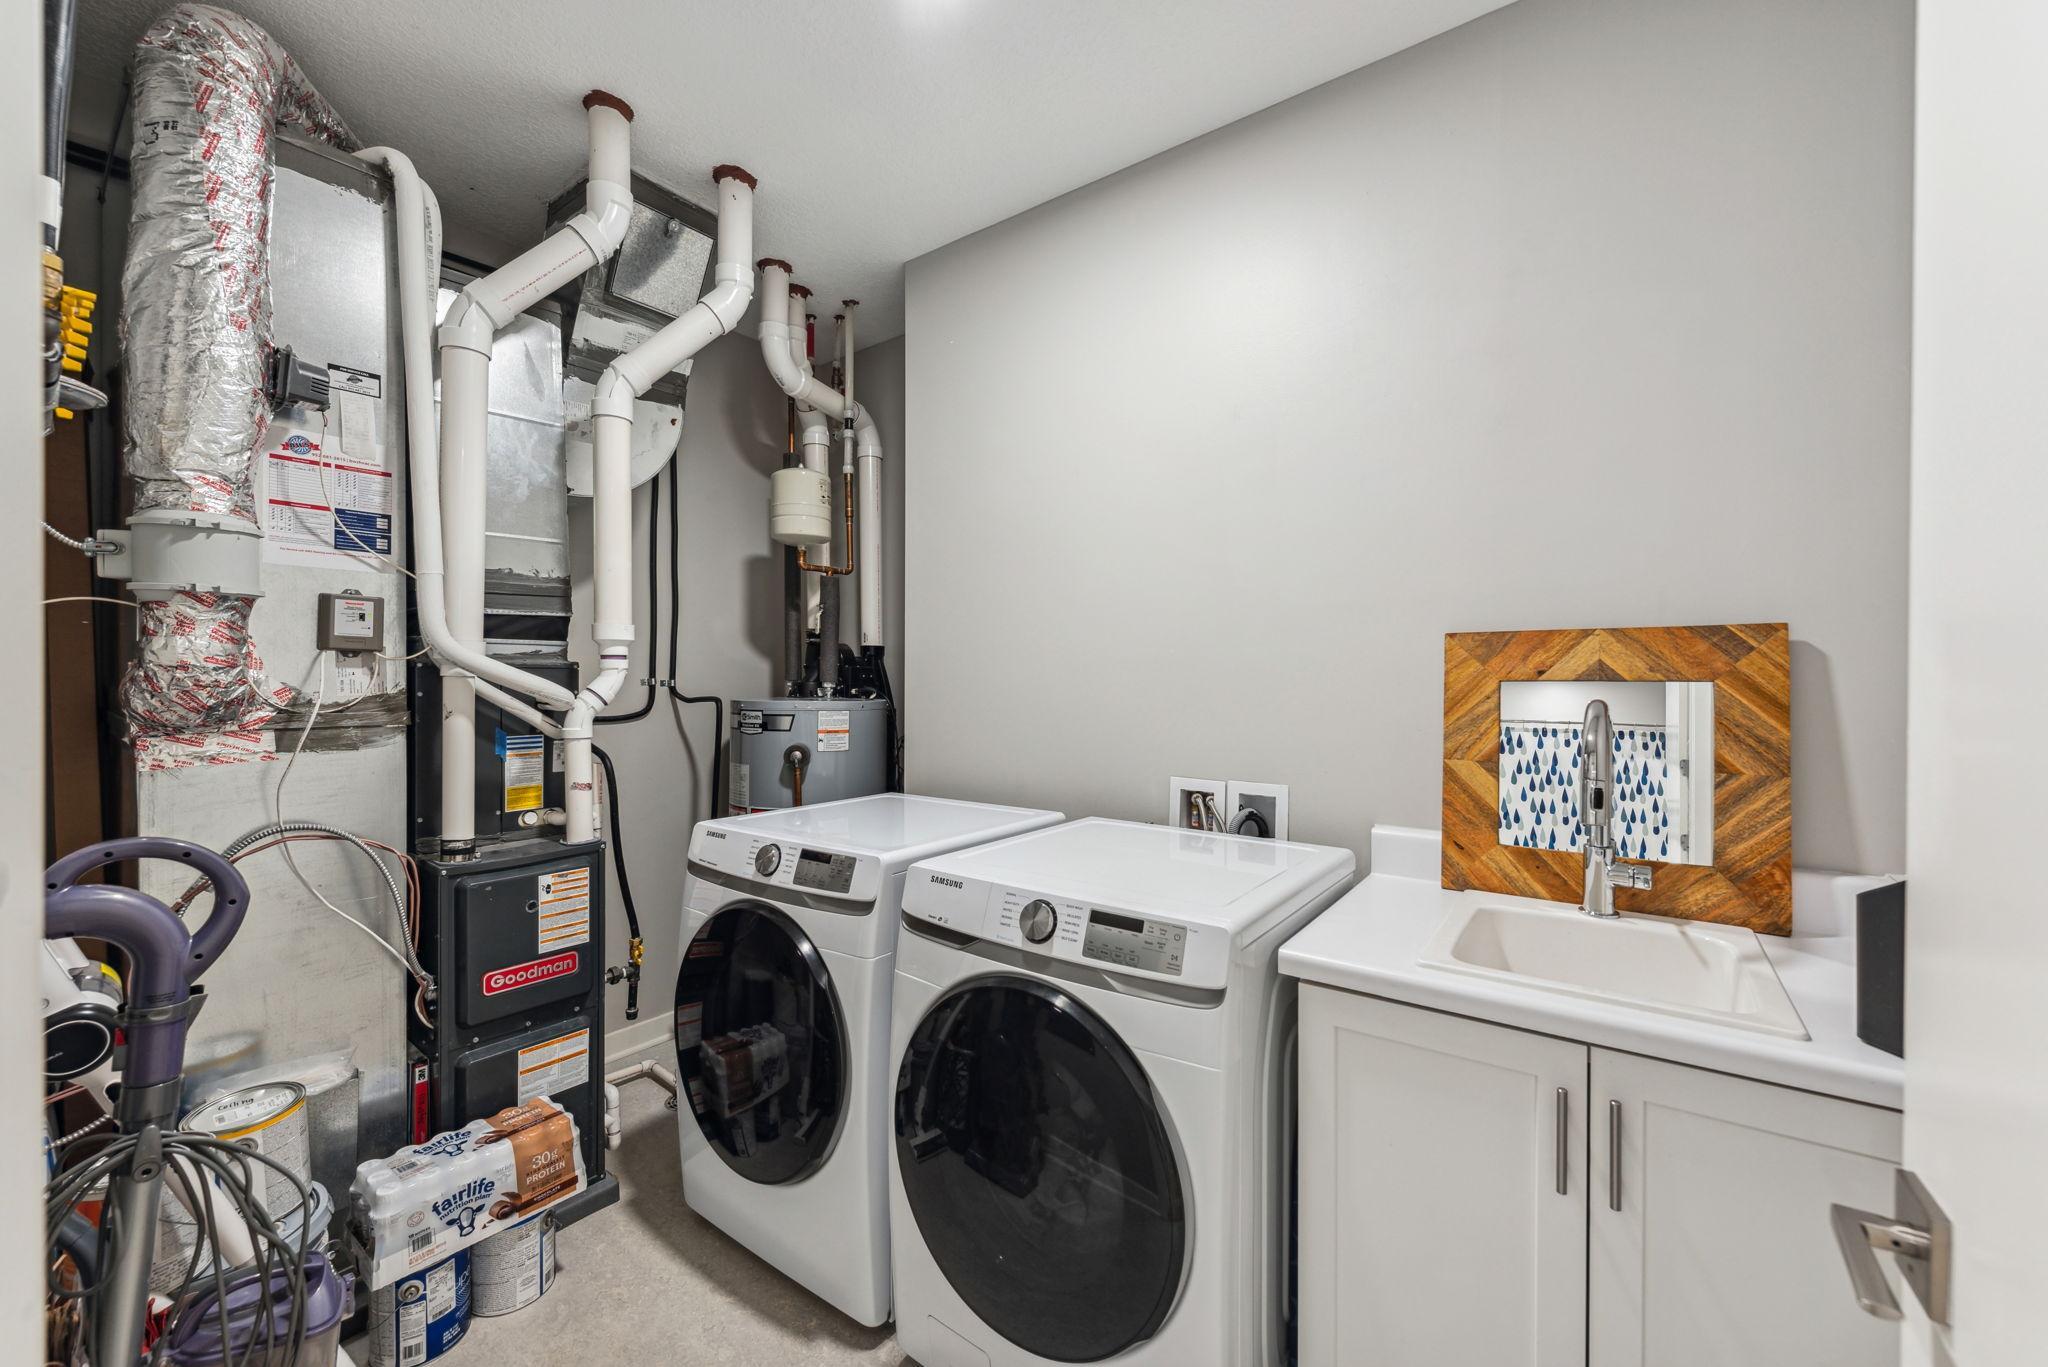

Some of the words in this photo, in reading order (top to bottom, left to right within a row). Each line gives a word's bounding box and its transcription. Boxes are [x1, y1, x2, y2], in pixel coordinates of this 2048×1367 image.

[706, 830, 727, 840] SAMSUNG
[930, 875, 964, 889] SAMSUNG
[490, 959, 573, 988] Goodman
[417, 1068, 426, 1081] 3M
[413, 1130, 472, 1154] fairlife
[532, 1148, 558, 1169] 30g
[526, 1160, 566, 1185] PROTEIN
[432, 1177, 495, 1217] fairlife
[440, 1199, 473, 1220] nutrition
